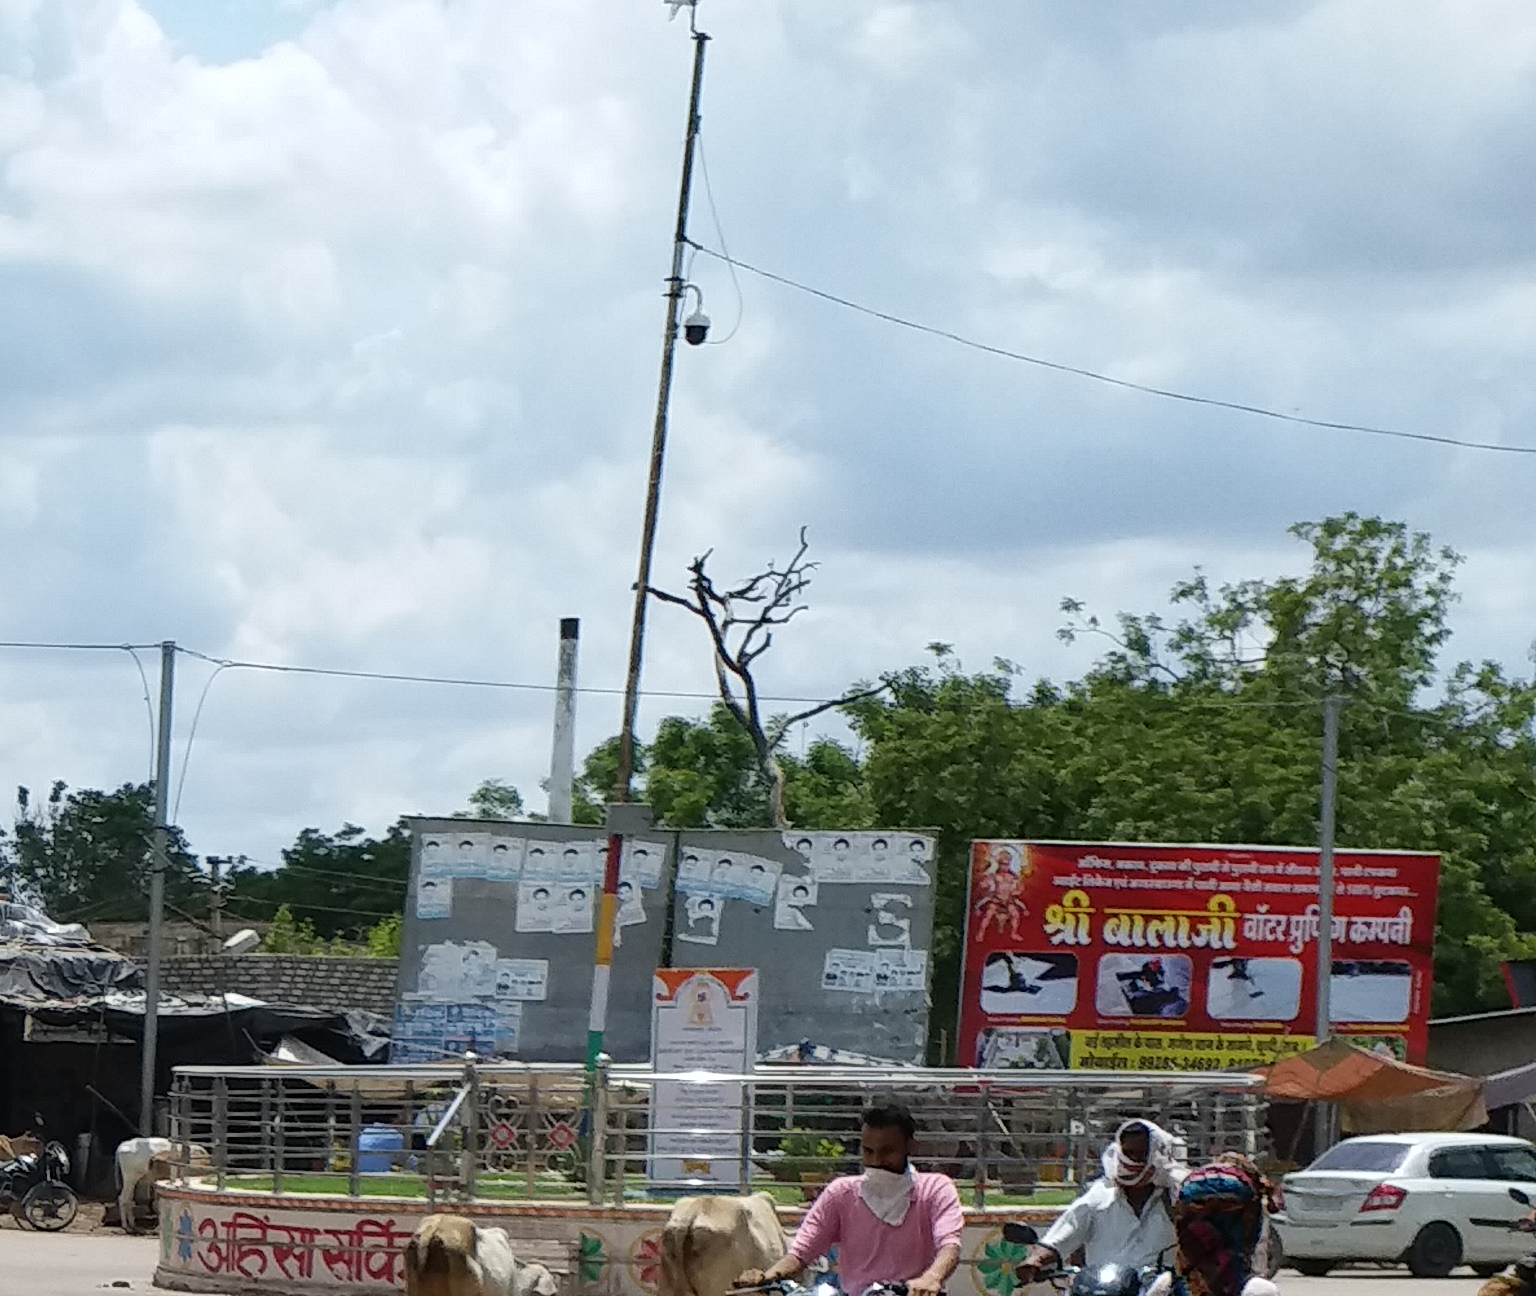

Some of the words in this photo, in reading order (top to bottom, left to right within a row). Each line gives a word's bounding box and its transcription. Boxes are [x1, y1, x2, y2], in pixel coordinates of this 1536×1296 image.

[1045, 890, 1096, 946] श्री
[1102, 893, 1242, 950] बालाजी
[1349, 906, 1413, 945] कम्पनी
[198, 1212, 322, 1282] अहिंसा
[322, 1219, 419, 1284] सर्कि
